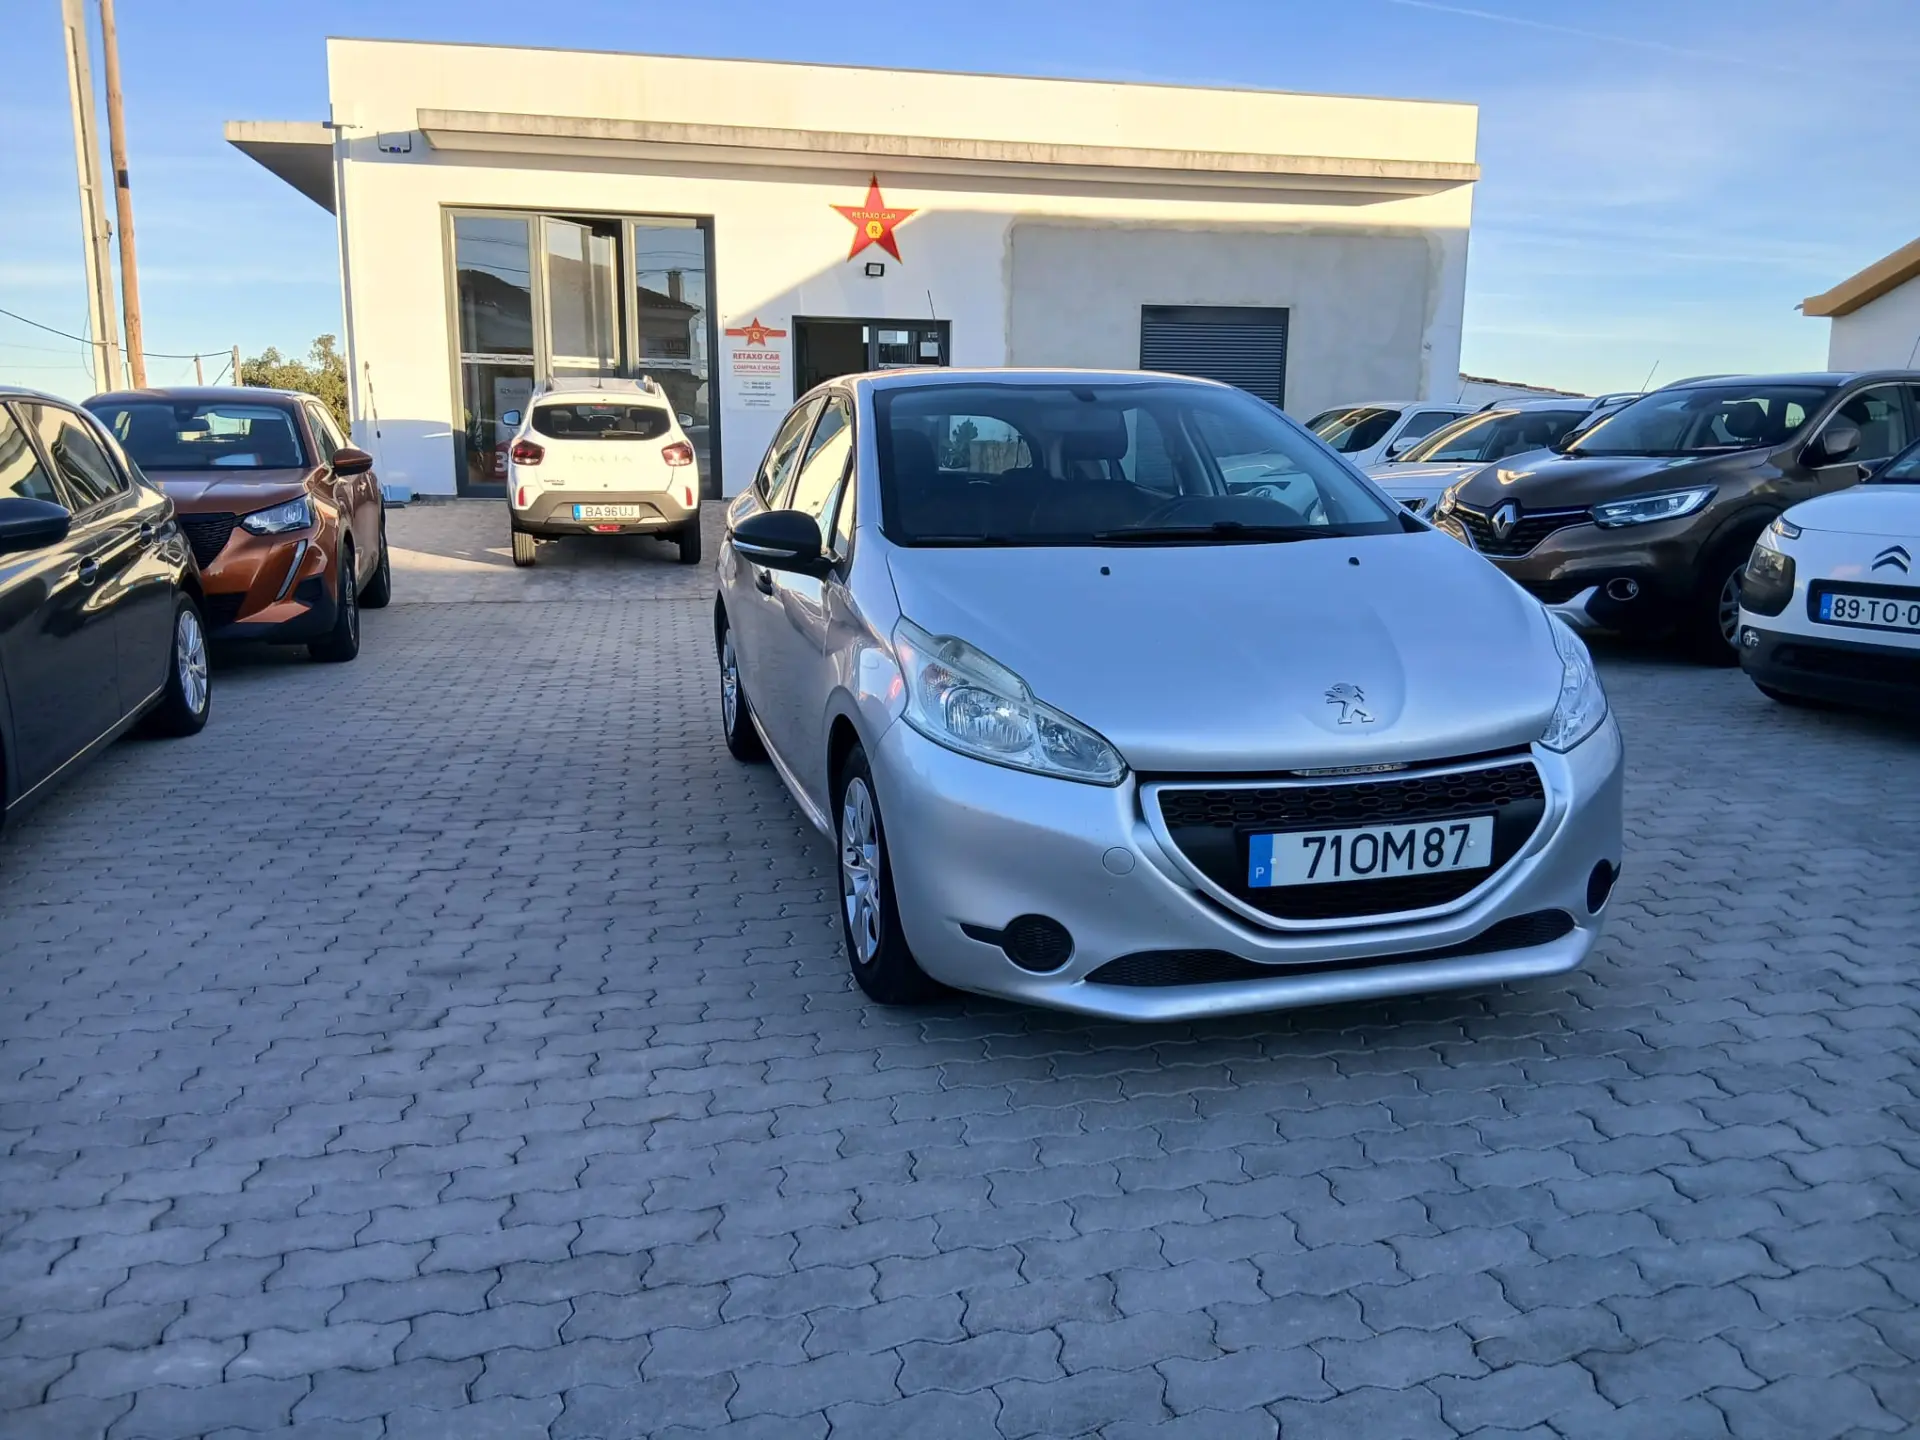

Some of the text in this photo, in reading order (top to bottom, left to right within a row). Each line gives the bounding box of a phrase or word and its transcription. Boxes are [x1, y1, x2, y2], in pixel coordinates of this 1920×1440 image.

[852, 211, 880, 219] RETAXO
[871, 225, 878, 234] R
[733, 352, 780, 361] RETAXO CAR
[1255, 866, 1265, 880] P
